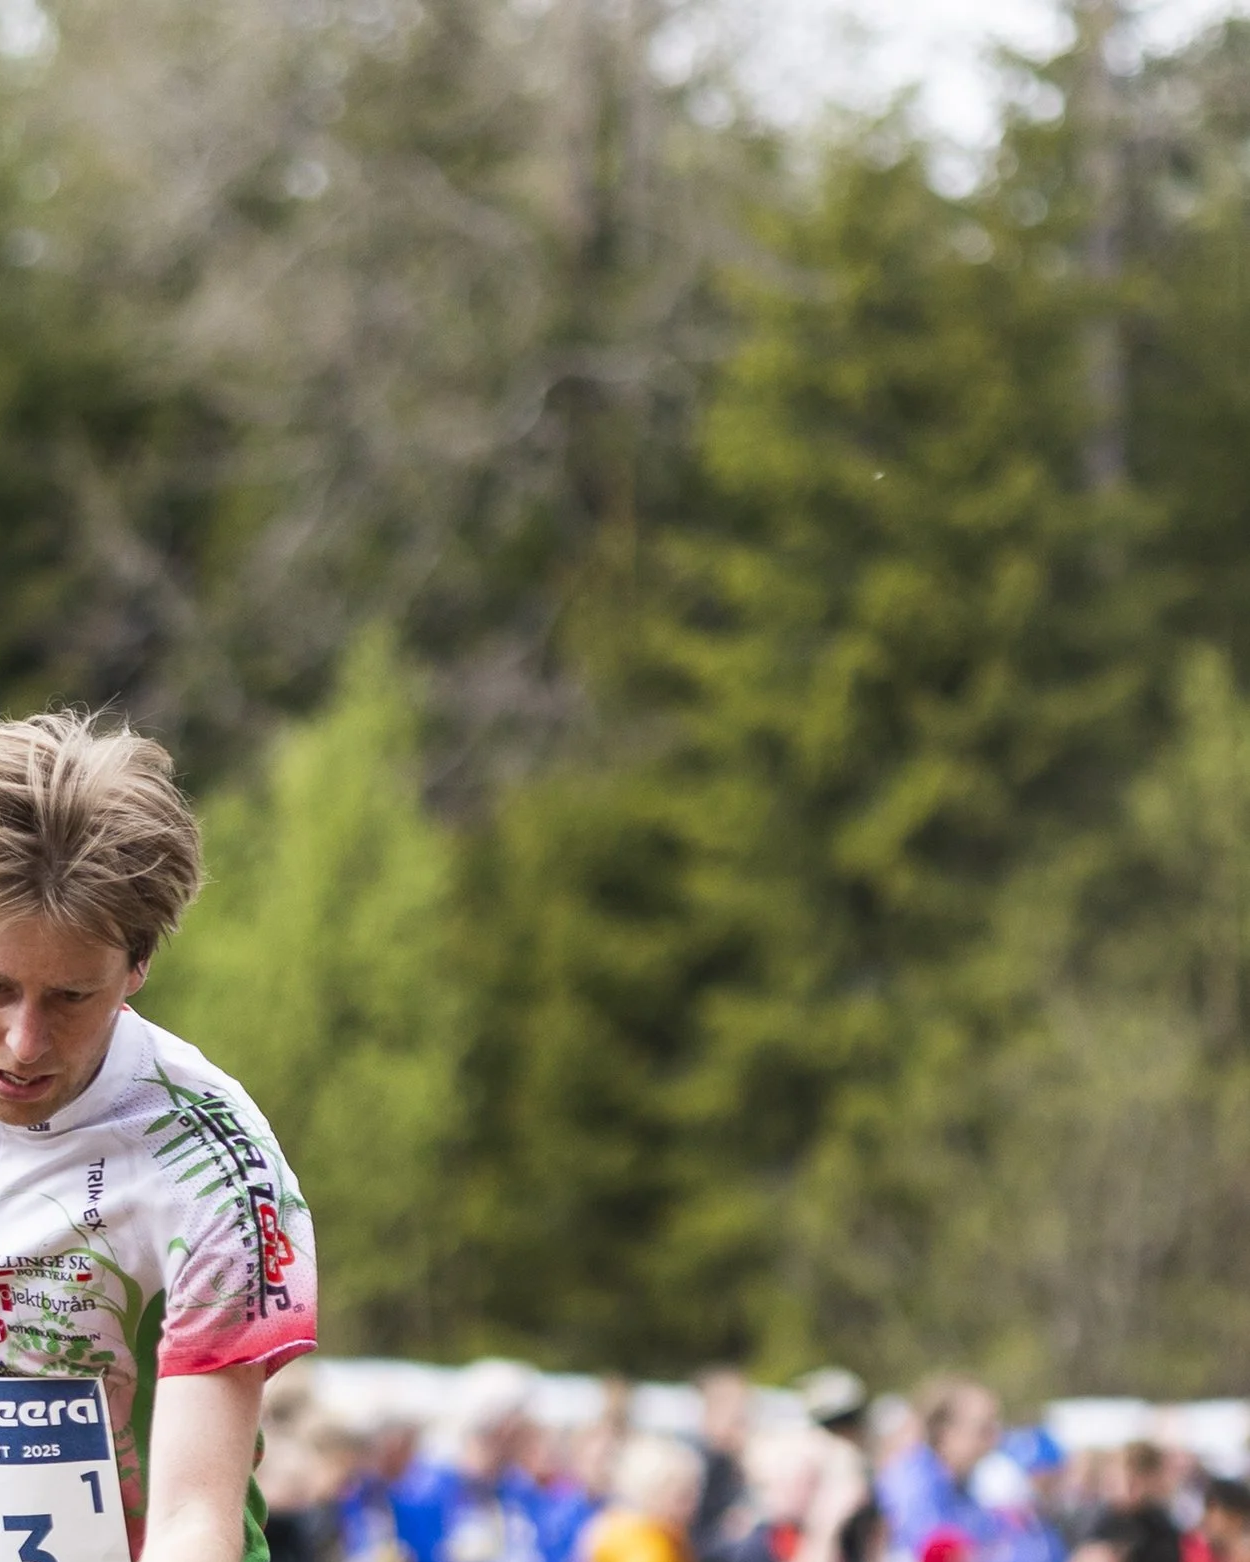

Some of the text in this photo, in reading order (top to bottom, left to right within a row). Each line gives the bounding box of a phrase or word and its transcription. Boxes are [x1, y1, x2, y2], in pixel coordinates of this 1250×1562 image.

[83, 1157, 107, 1232] TRIMEX
[69, 1255, 92, 1271] SK
[22, 1444, 61, 1458] 2025
[80, 1470, 104, 1514] 1
